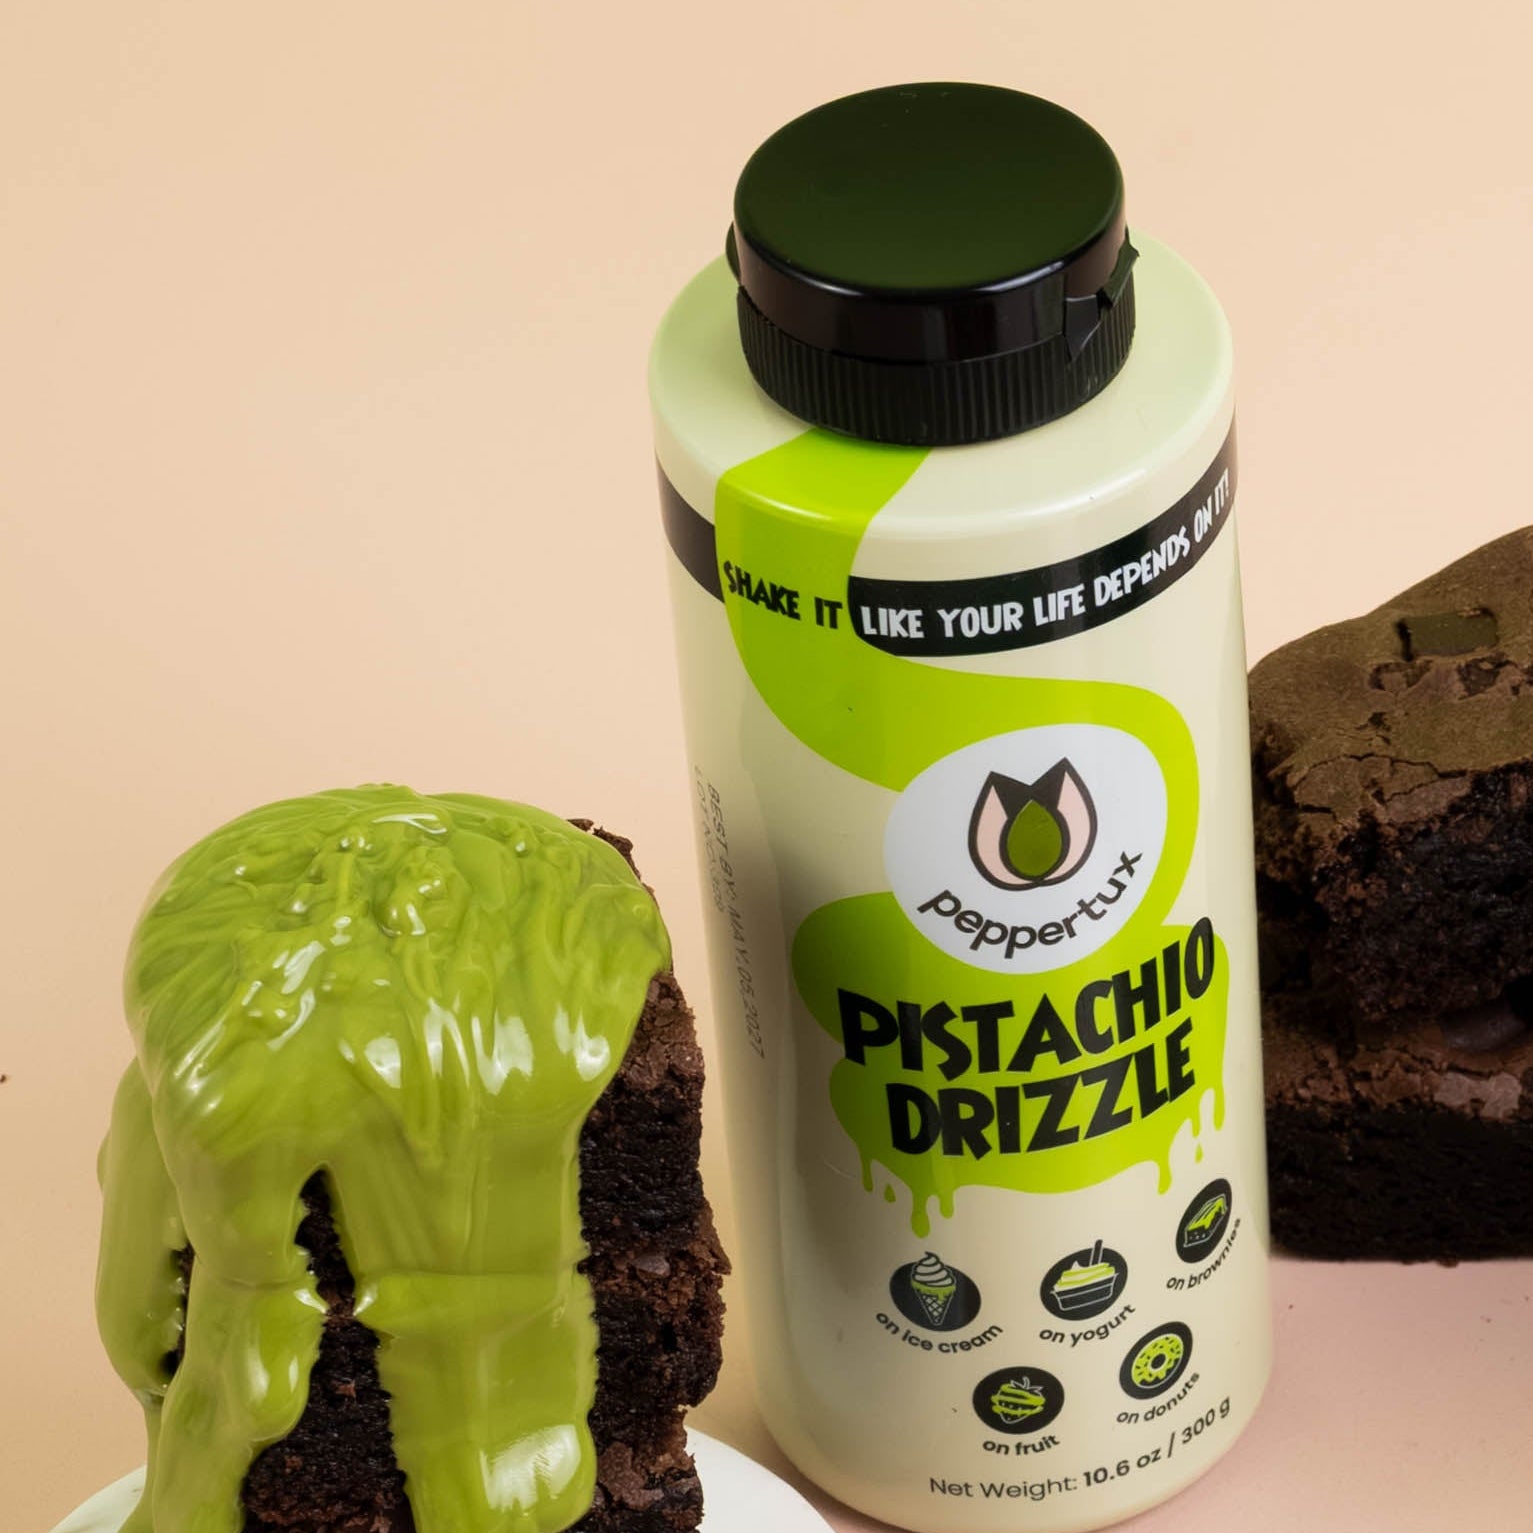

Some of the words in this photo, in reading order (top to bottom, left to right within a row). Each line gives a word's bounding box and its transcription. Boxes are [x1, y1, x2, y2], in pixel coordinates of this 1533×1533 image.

[723, 559, 800, 621] SHAKE
[814, 597, 843, 630] IT
[860, 606, 925, 639] LIKE
[936, 601, 1023, 639] YOUR
[1033, 584, 1086, 628] LIFE
[1094, 525, 1191, 607] DEPENDS
[1194, 494, 1213, 543] ON
[1214, 467, 1229, 516] IT!
[708, 782, 729, 852] BEST
[917, 851, 1143, 960] peppertux
[837, 915, 1216, 1081] PISTACHIO
[885, 1017, 1197, 1161] DRIZZLE
[1166, 1277, 1185, 1290] on
[1187, 1217, 1241, 1289] brownies
[876, 1312, 900, 1337] on
[901, 1326, 934, 1352] ice
[938, 1324, 1004, 1354] cream
[1039, 1327, 1065, 1345] on
[1070, 1303, 1136, 1348] yogurt
[1116, 1410, 1139, 1425] on
[1143, 1371, 1200, 1423] donuts
[929, 1476, 973, 1498] Net
[980, 1476, 1078, 1501] Weight:
[1083, 1460, 1130, 1488] 10.6
[1136, 1447, 1162, 1469] oz
[1167, 1432, 1176, 1459] /
[1182, 1408, 1217, 1446] 300
[1219, 1396, 1232, 1419] g
[982, 1439, 1010, 1455] on
[1015, 1434, 1060, 1456] fruit
